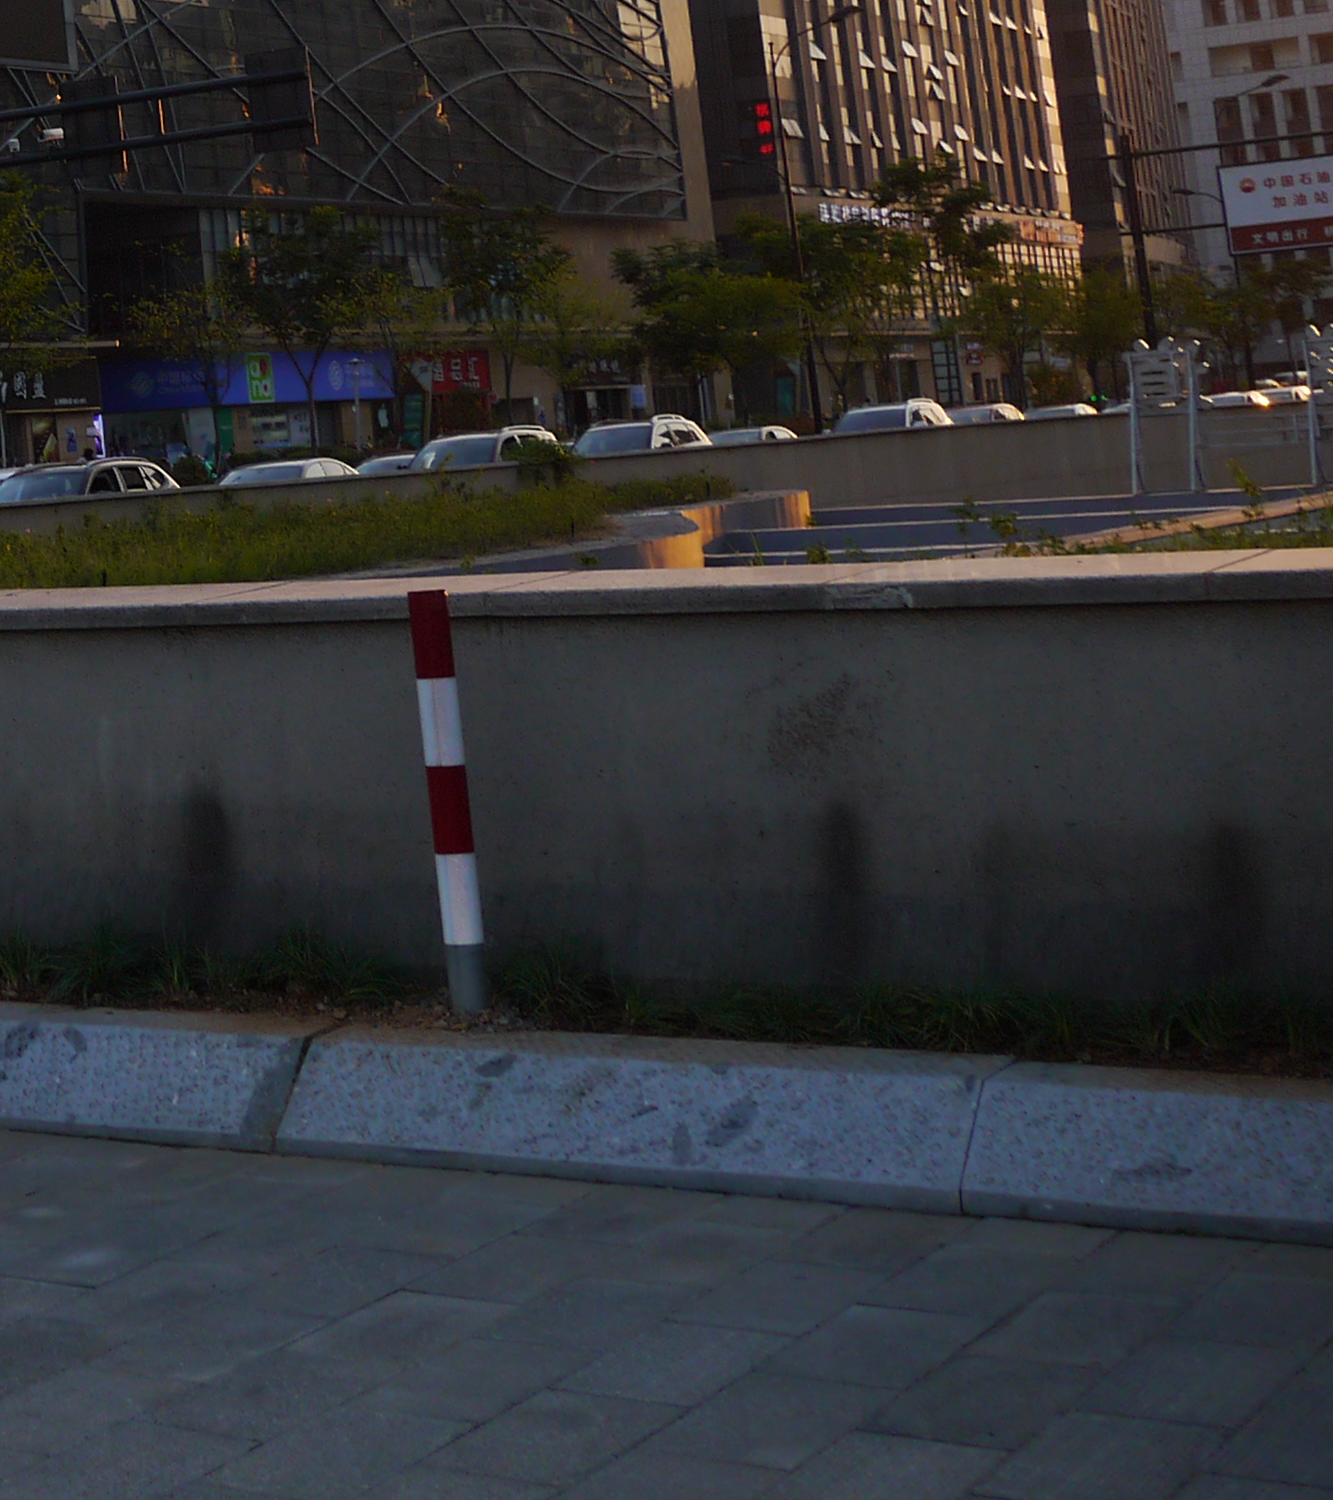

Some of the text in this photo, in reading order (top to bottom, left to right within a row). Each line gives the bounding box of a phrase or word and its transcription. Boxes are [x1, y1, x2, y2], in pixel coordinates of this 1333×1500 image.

[1263, 171, 1331, 189] 中国石油
[1273, 190, 1329, 209] 加油站
